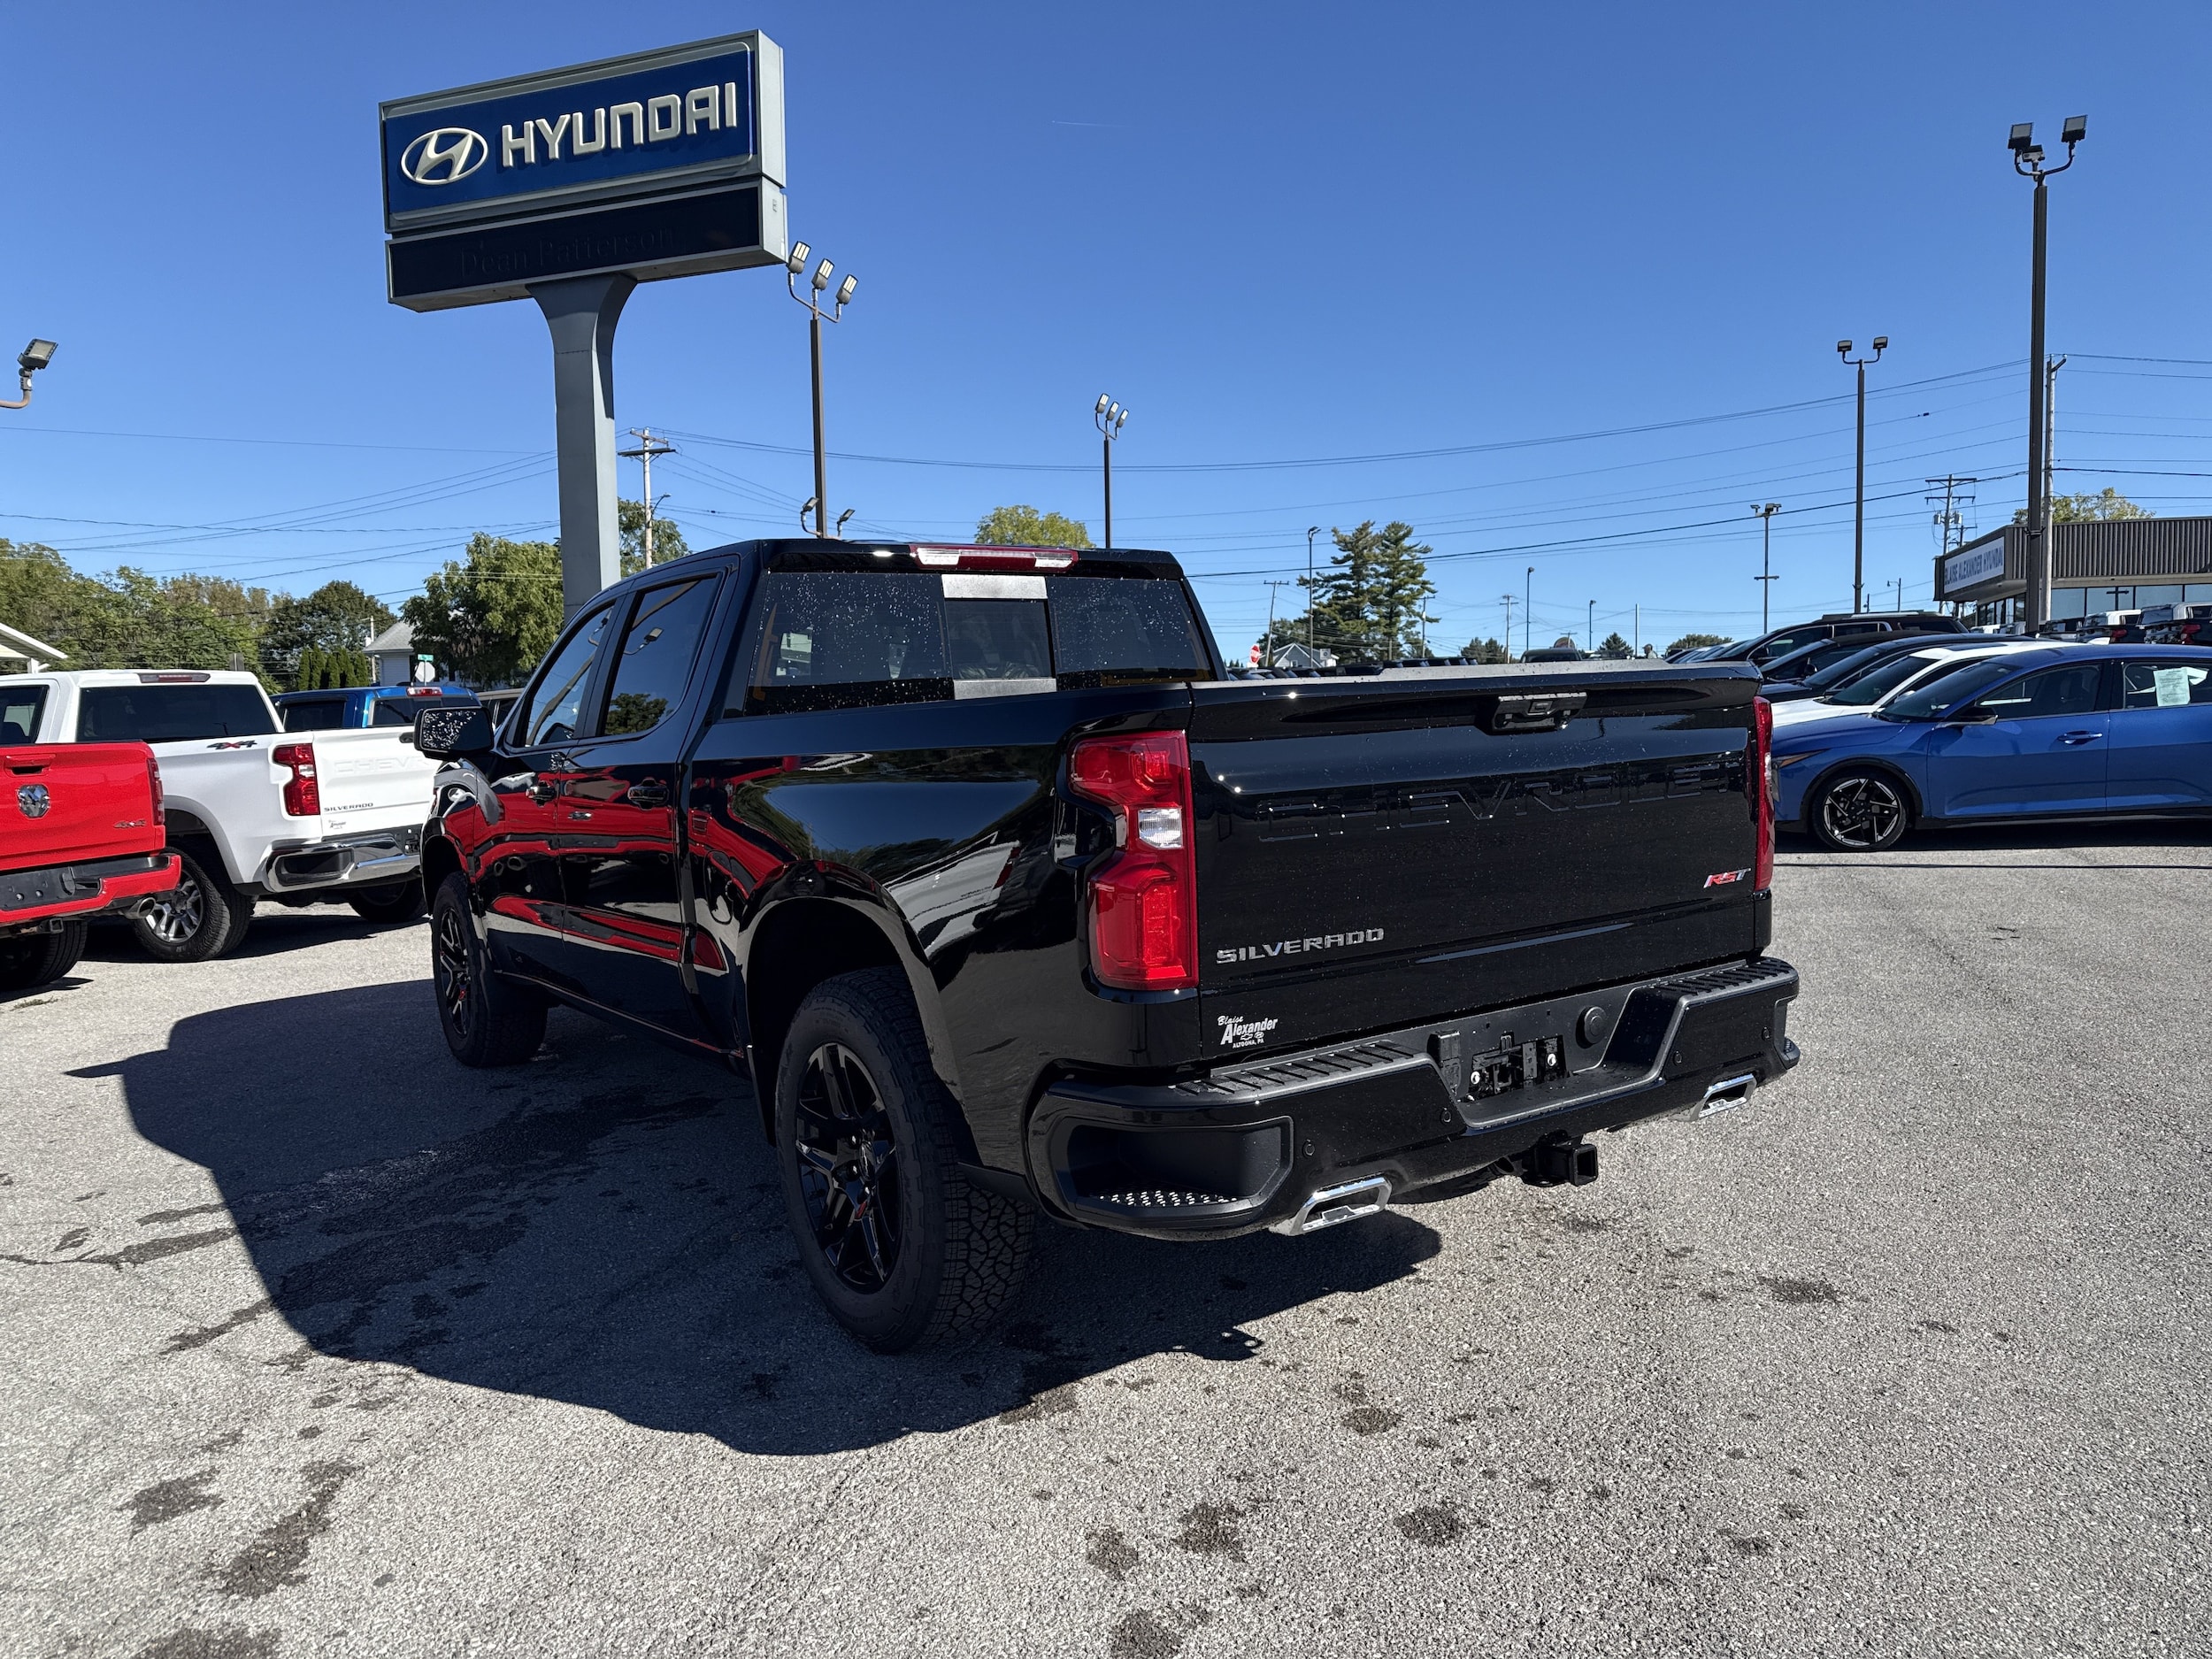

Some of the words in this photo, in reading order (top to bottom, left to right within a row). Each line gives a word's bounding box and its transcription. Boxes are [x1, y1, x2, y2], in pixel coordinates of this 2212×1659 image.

[502, 81, 737, 167] HYUNDAI
[461, 246, 528, 277] Dean
[539, 227, 676, 265] Patterson
[324, 803, 373, 812] SILVERADO
[1257, 761, 1740, 843] CHEVROLET
[1703, 868, 1751, 888] RST
[1216, 928, 1385, 964] SILVERADO
[1217, 1015, 1244, 1025] Blaise
[1220, 1018, 1279, 1045] Alexander
